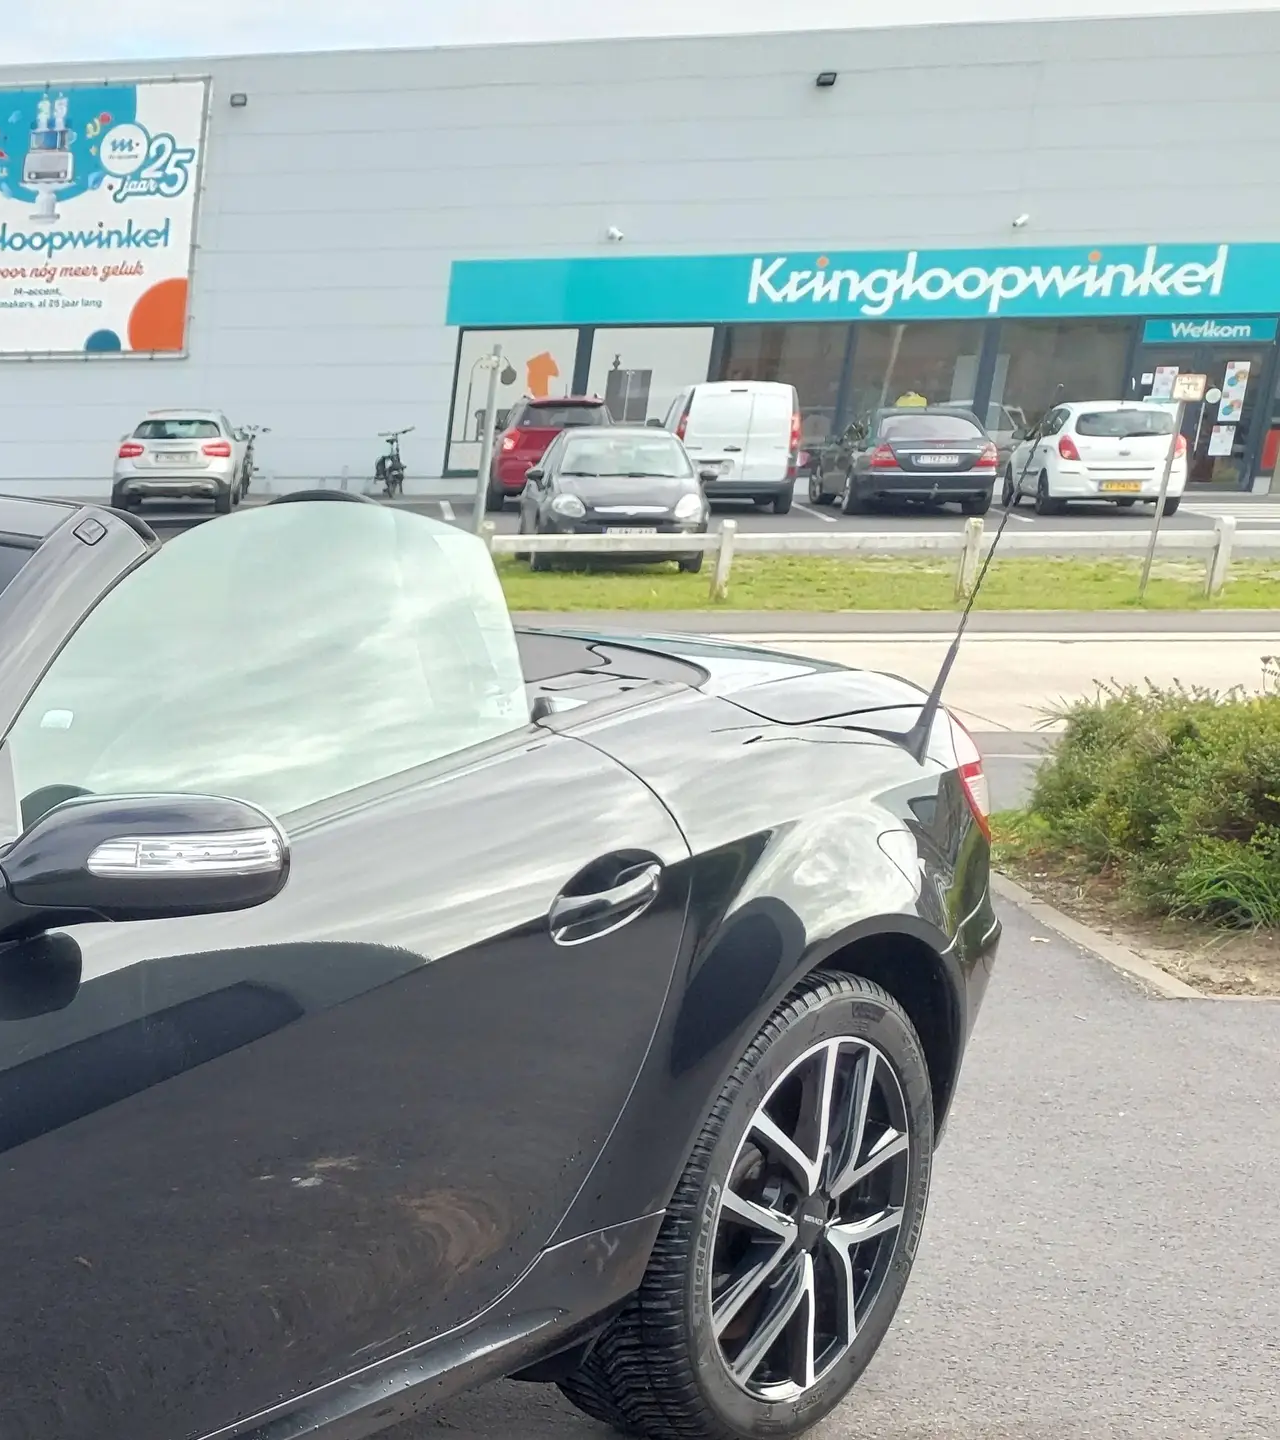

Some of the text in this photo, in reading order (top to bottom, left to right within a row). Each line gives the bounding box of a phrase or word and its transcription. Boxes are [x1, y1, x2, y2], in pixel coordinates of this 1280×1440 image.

[140, 135, 193, 196] 25
[116, 174, 158, 200] jaar
[59, 265, 98, 277] meer
[101, 260, 144, 281] geluk
[748, 244, 1228, 316] Kringloopwinkel
[1171, 320, 1251, 338] Welkom
